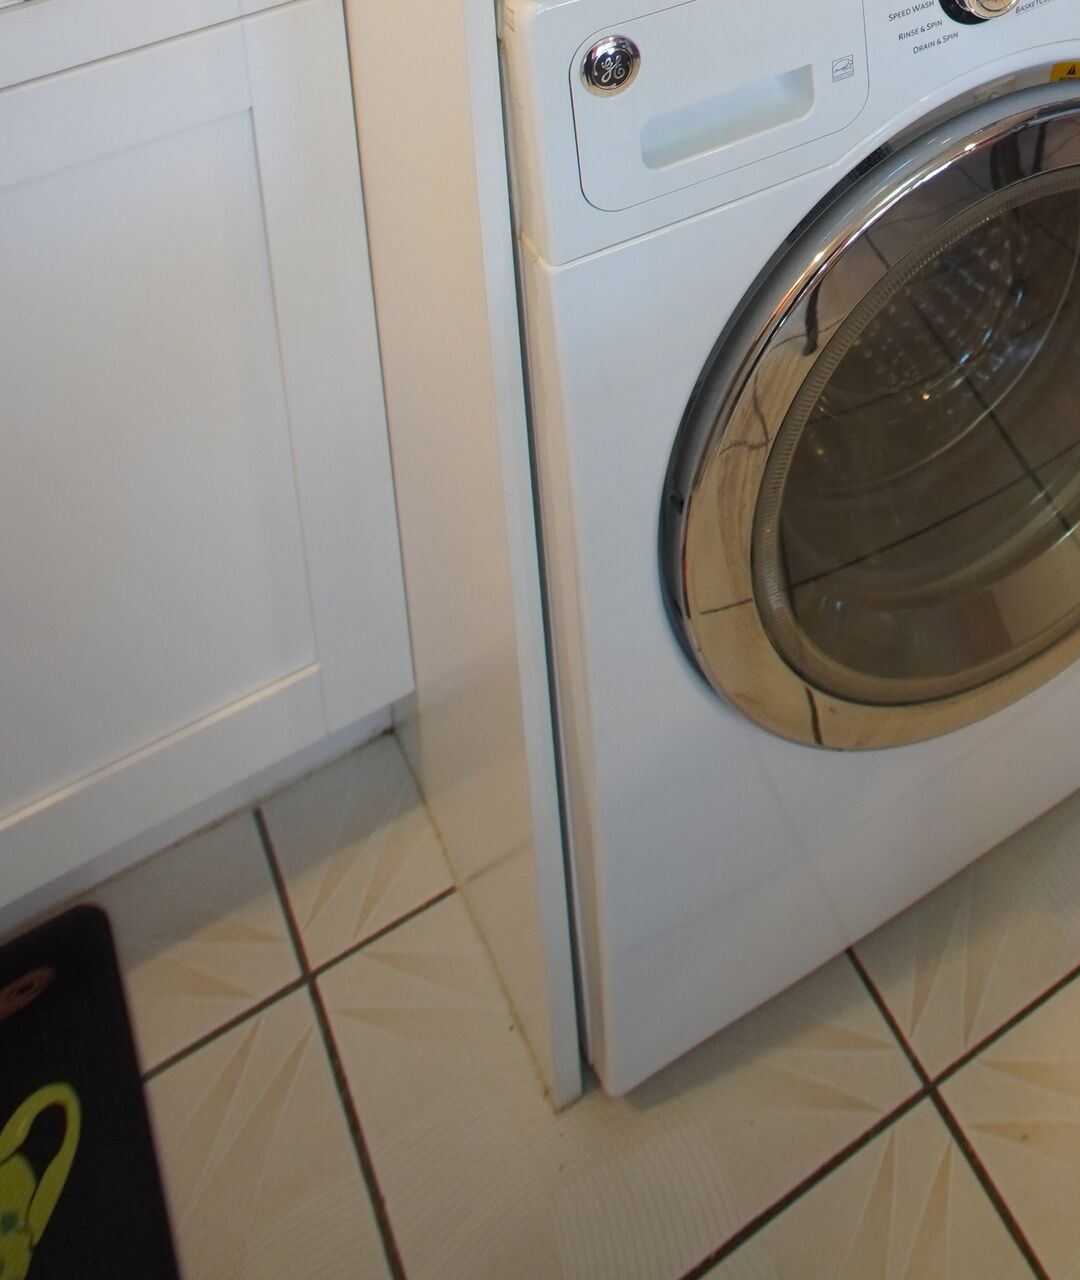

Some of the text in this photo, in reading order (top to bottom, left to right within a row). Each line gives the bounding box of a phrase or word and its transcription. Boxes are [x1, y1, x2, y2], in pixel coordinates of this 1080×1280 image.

[888, 0, 934, 22] SPEED WASH
[898, 27, 919, 41] RINSE
[926, 19, 943, 31] SPIN
[912, 40, 936, 54] DRAIN
[942, 32, 959, 43] SPIN
